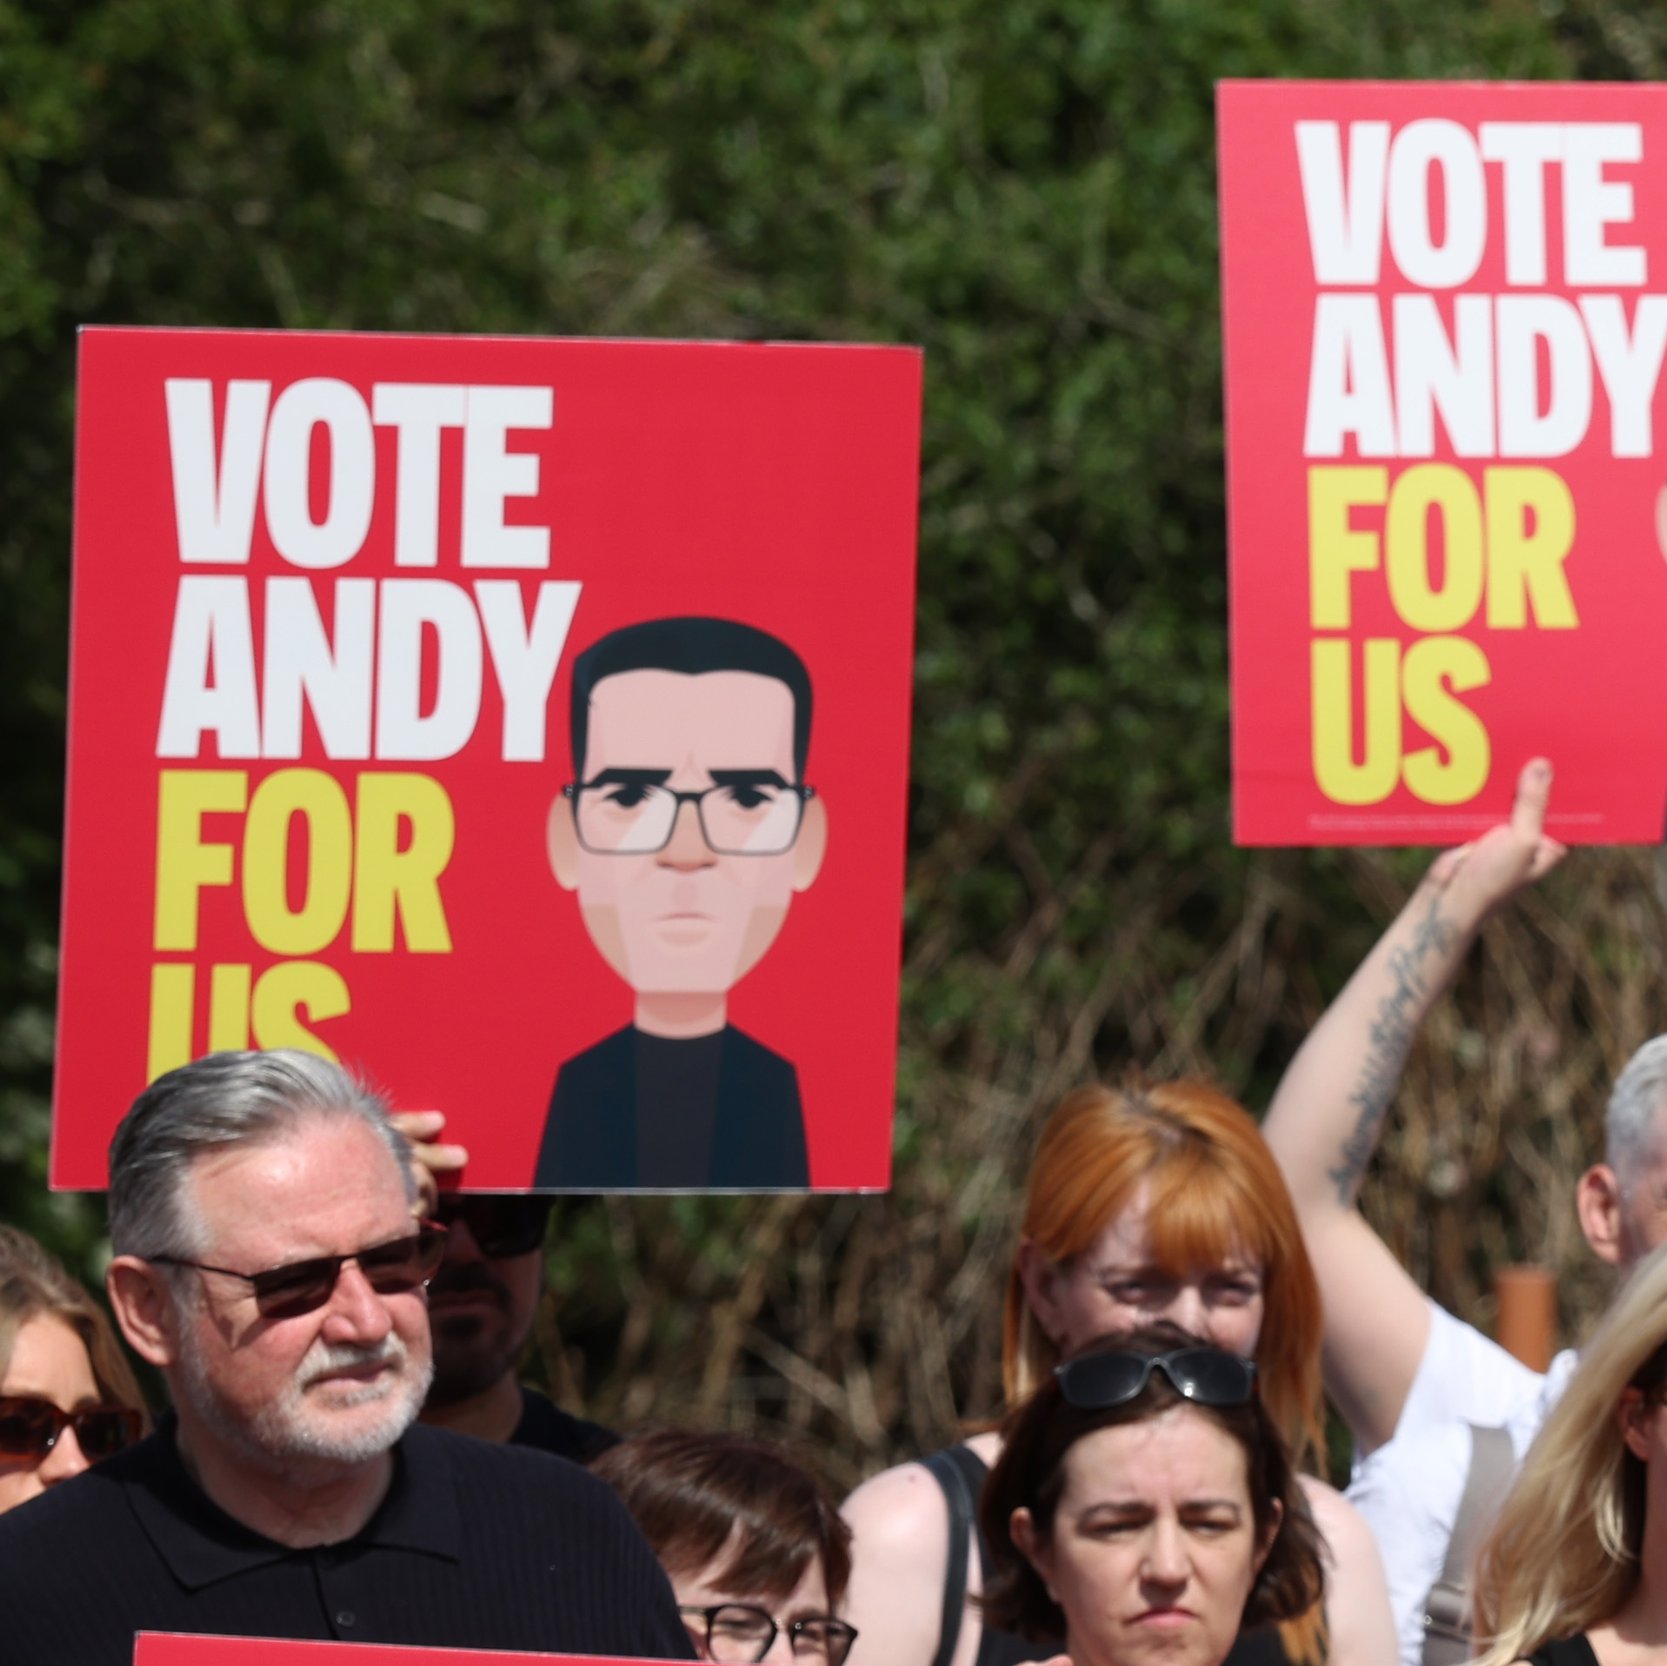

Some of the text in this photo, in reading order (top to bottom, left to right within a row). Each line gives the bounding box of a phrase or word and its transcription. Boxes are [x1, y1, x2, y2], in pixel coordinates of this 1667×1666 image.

[1295, 118, 1647, 288] VOTE
[165, 377, 554, 568] VOTE
[1307, 463, 1579, 632] FOR
[156, 575, 582, 762] ANDY
[1311, 635, 1491, 805] US
[154, 768, 455, 955] FOR
